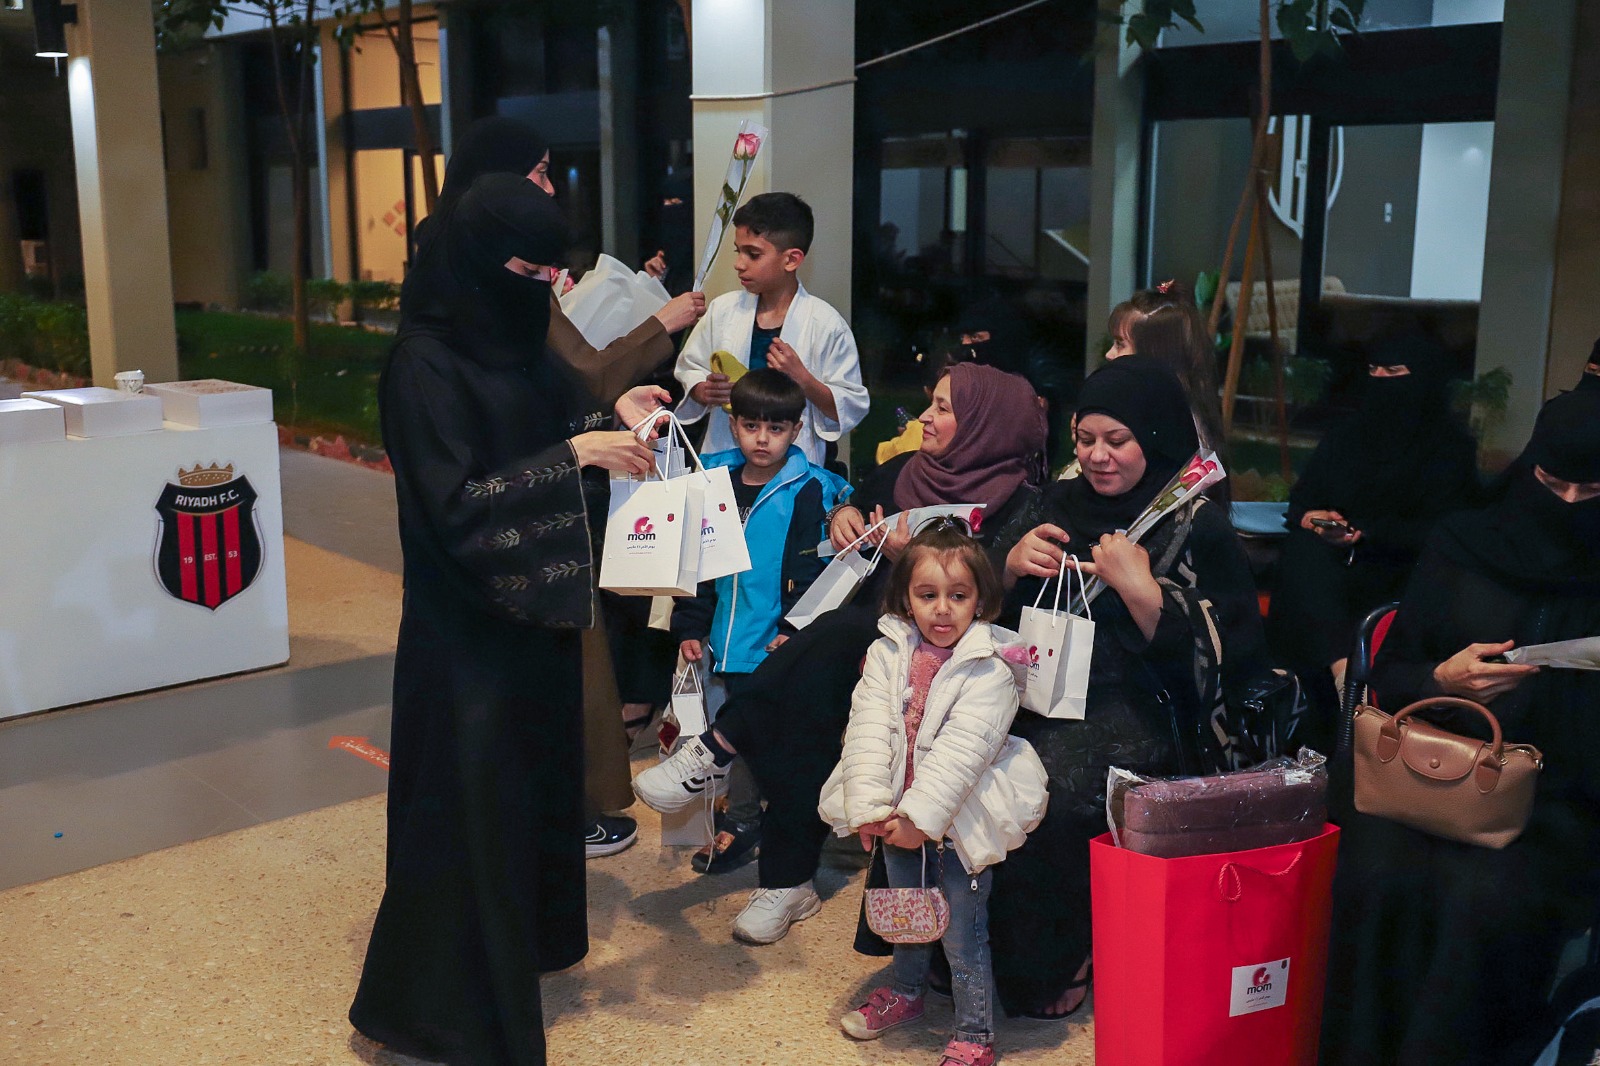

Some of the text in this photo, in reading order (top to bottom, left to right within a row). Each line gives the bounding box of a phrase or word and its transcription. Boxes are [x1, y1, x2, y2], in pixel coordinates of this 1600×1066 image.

[175, 489, 240, 507] RIYADH F.C.
[627, 533, 656, 541] mom
[204, 553, 217, 561] EST.
[228, 550, 238, 558] 53
[1246, 983, 1272, 994] mom
